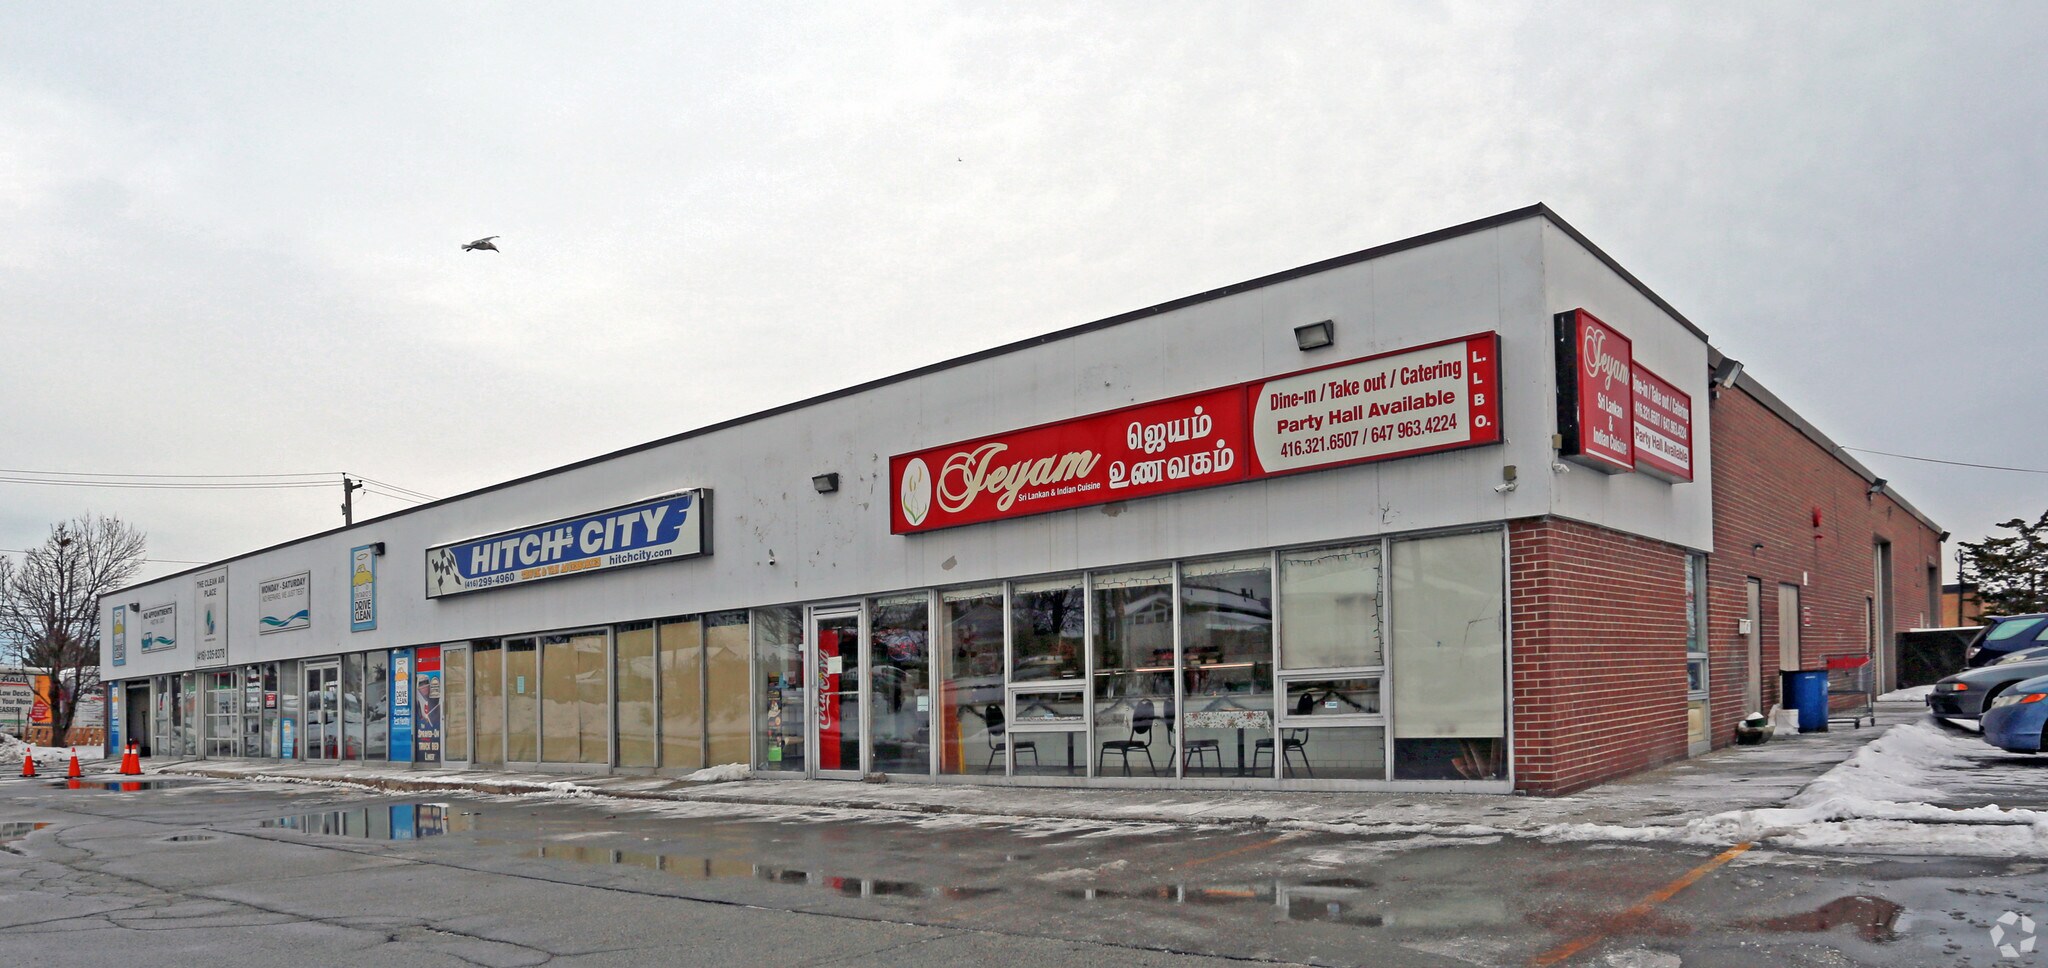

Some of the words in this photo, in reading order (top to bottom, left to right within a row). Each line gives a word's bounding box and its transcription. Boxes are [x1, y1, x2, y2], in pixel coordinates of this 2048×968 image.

[1584, 326, 1630, 391] Jeyam
[1320, 383, 1326, 402] /
[1329, 379, 1359, 399] Take
[1364, 372, 1386, 392] out
[1390, 369, 1396, 388] /
[1401, 360, 1461, 385] Catering
[1127, 405, 1212, 454] ஜெயம்
[1277, 414, 1323, 434] Party
[1329, 405, 1362, 425] Hall
[1368, 390, 1455, 418] Available
[1281, 430, 1359, 457] 416.321.6507
[1363, 428, 1368, 445] /
[1371, 424, 1394, 443] 647
[1398, 413, 1457, 438] 963.4224
[1635, 426, 1651, 449] Party
[1652, 434, 1663, 452] Hall
[1664, 440, 1687, 463] Available
[937, 442, 1101, 513] Jeyam
[1109, 439, 1234, 489] உணவகம்
[1018, 493, 1027, 502] Sri
[1028, 491, 1050, 500] Lankan
[1057, 486, 1076, 495] Indian
[1077, 482, 1101, 492] Cuisine
[470, 528, 565, 575] HITCH
[580, 505, 670, 554] CITY
[609, 548, 672, 565] hitchcity.com
[282, 577, 306, 589] SATURDAY
[355, 600, 371, 612] DRIVE
[355, 610, 371, 621] CLEAN
